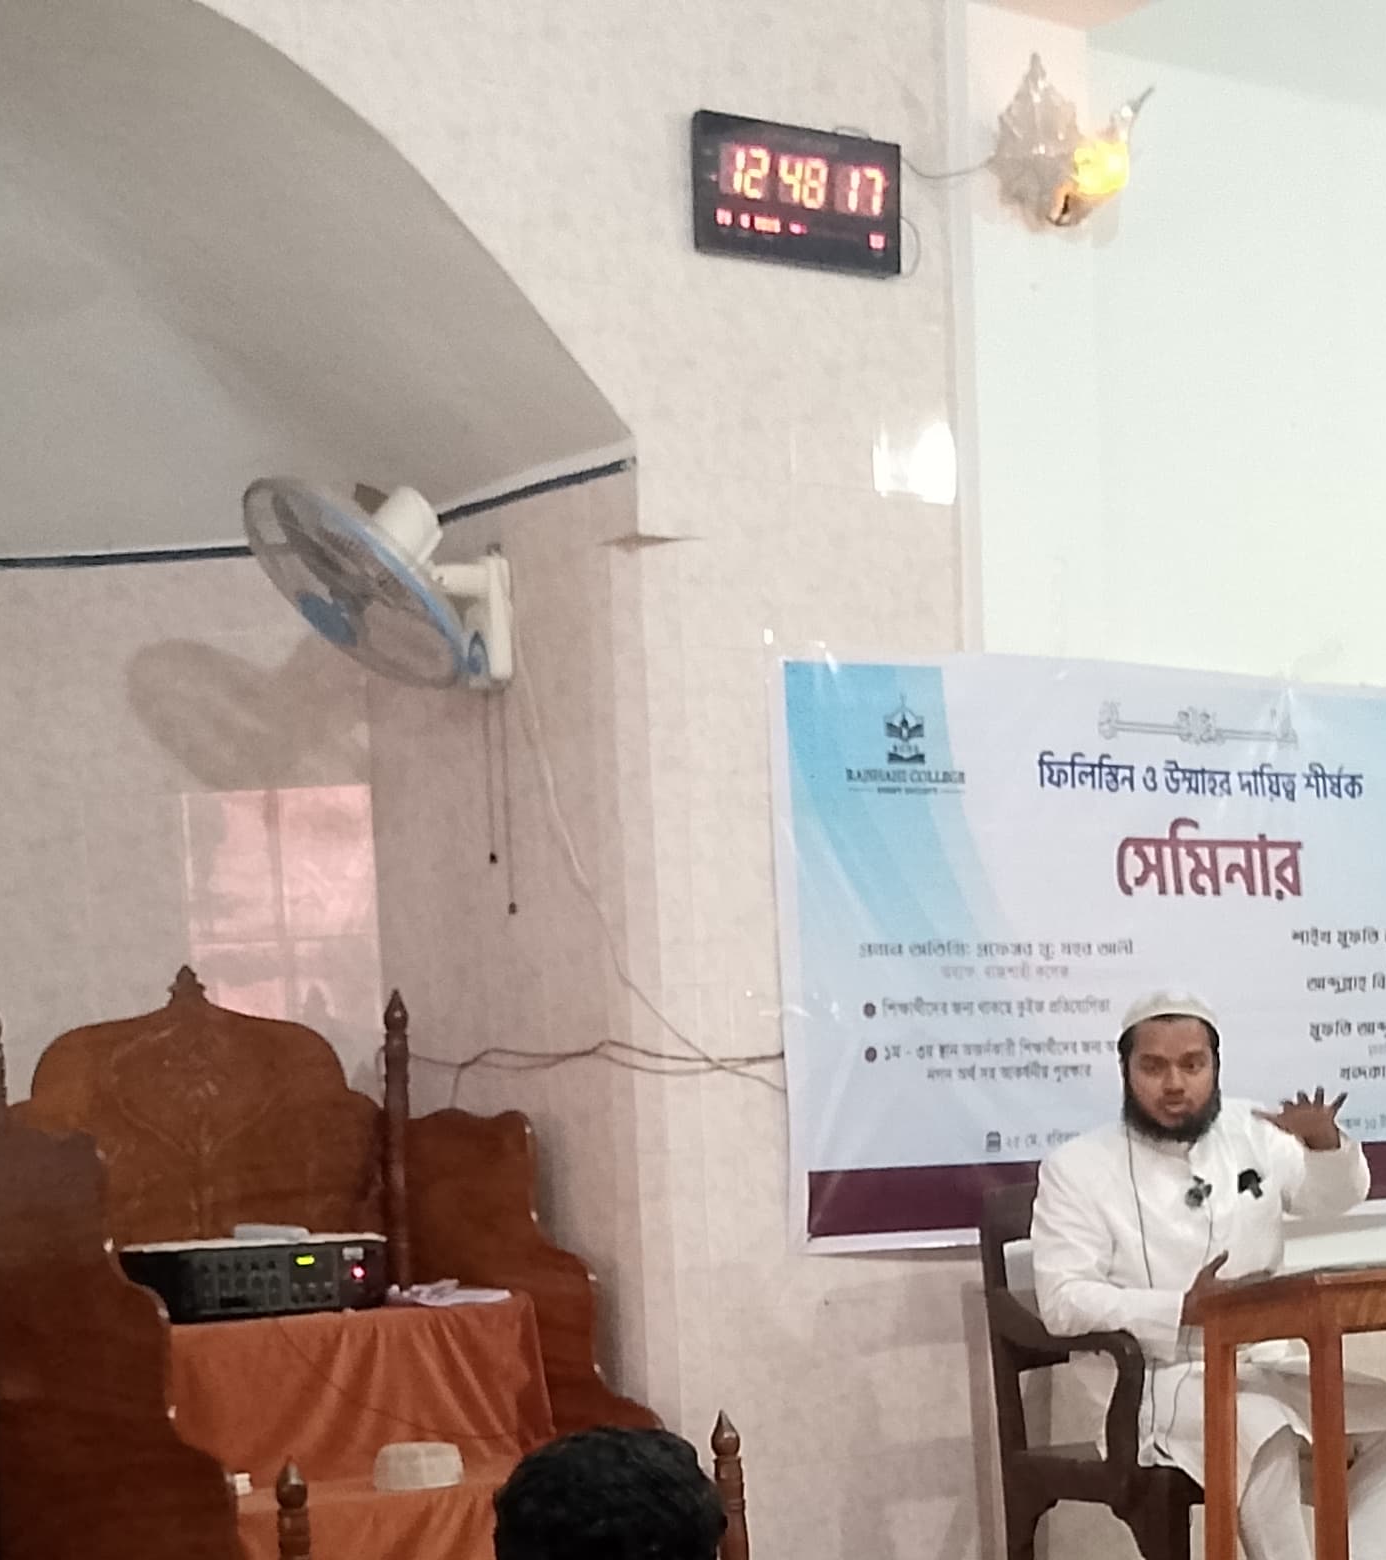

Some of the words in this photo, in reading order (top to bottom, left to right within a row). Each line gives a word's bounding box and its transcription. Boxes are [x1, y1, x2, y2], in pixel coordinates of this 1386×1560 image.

[733, 146, 770, 200] 12
[778, 155, 829, 210] 48
[848, 165, 885, 216] 17
[1038, 750, 1135, 792] ফিলিস্তিন
[1142, 766, 1157, 792] ও
[1164, 760, 1232, 797] উম্মাহর
[1305, 761, 1363, 799] শীর্ষক
[1117, 817, 1302, 900] সেমিনার
